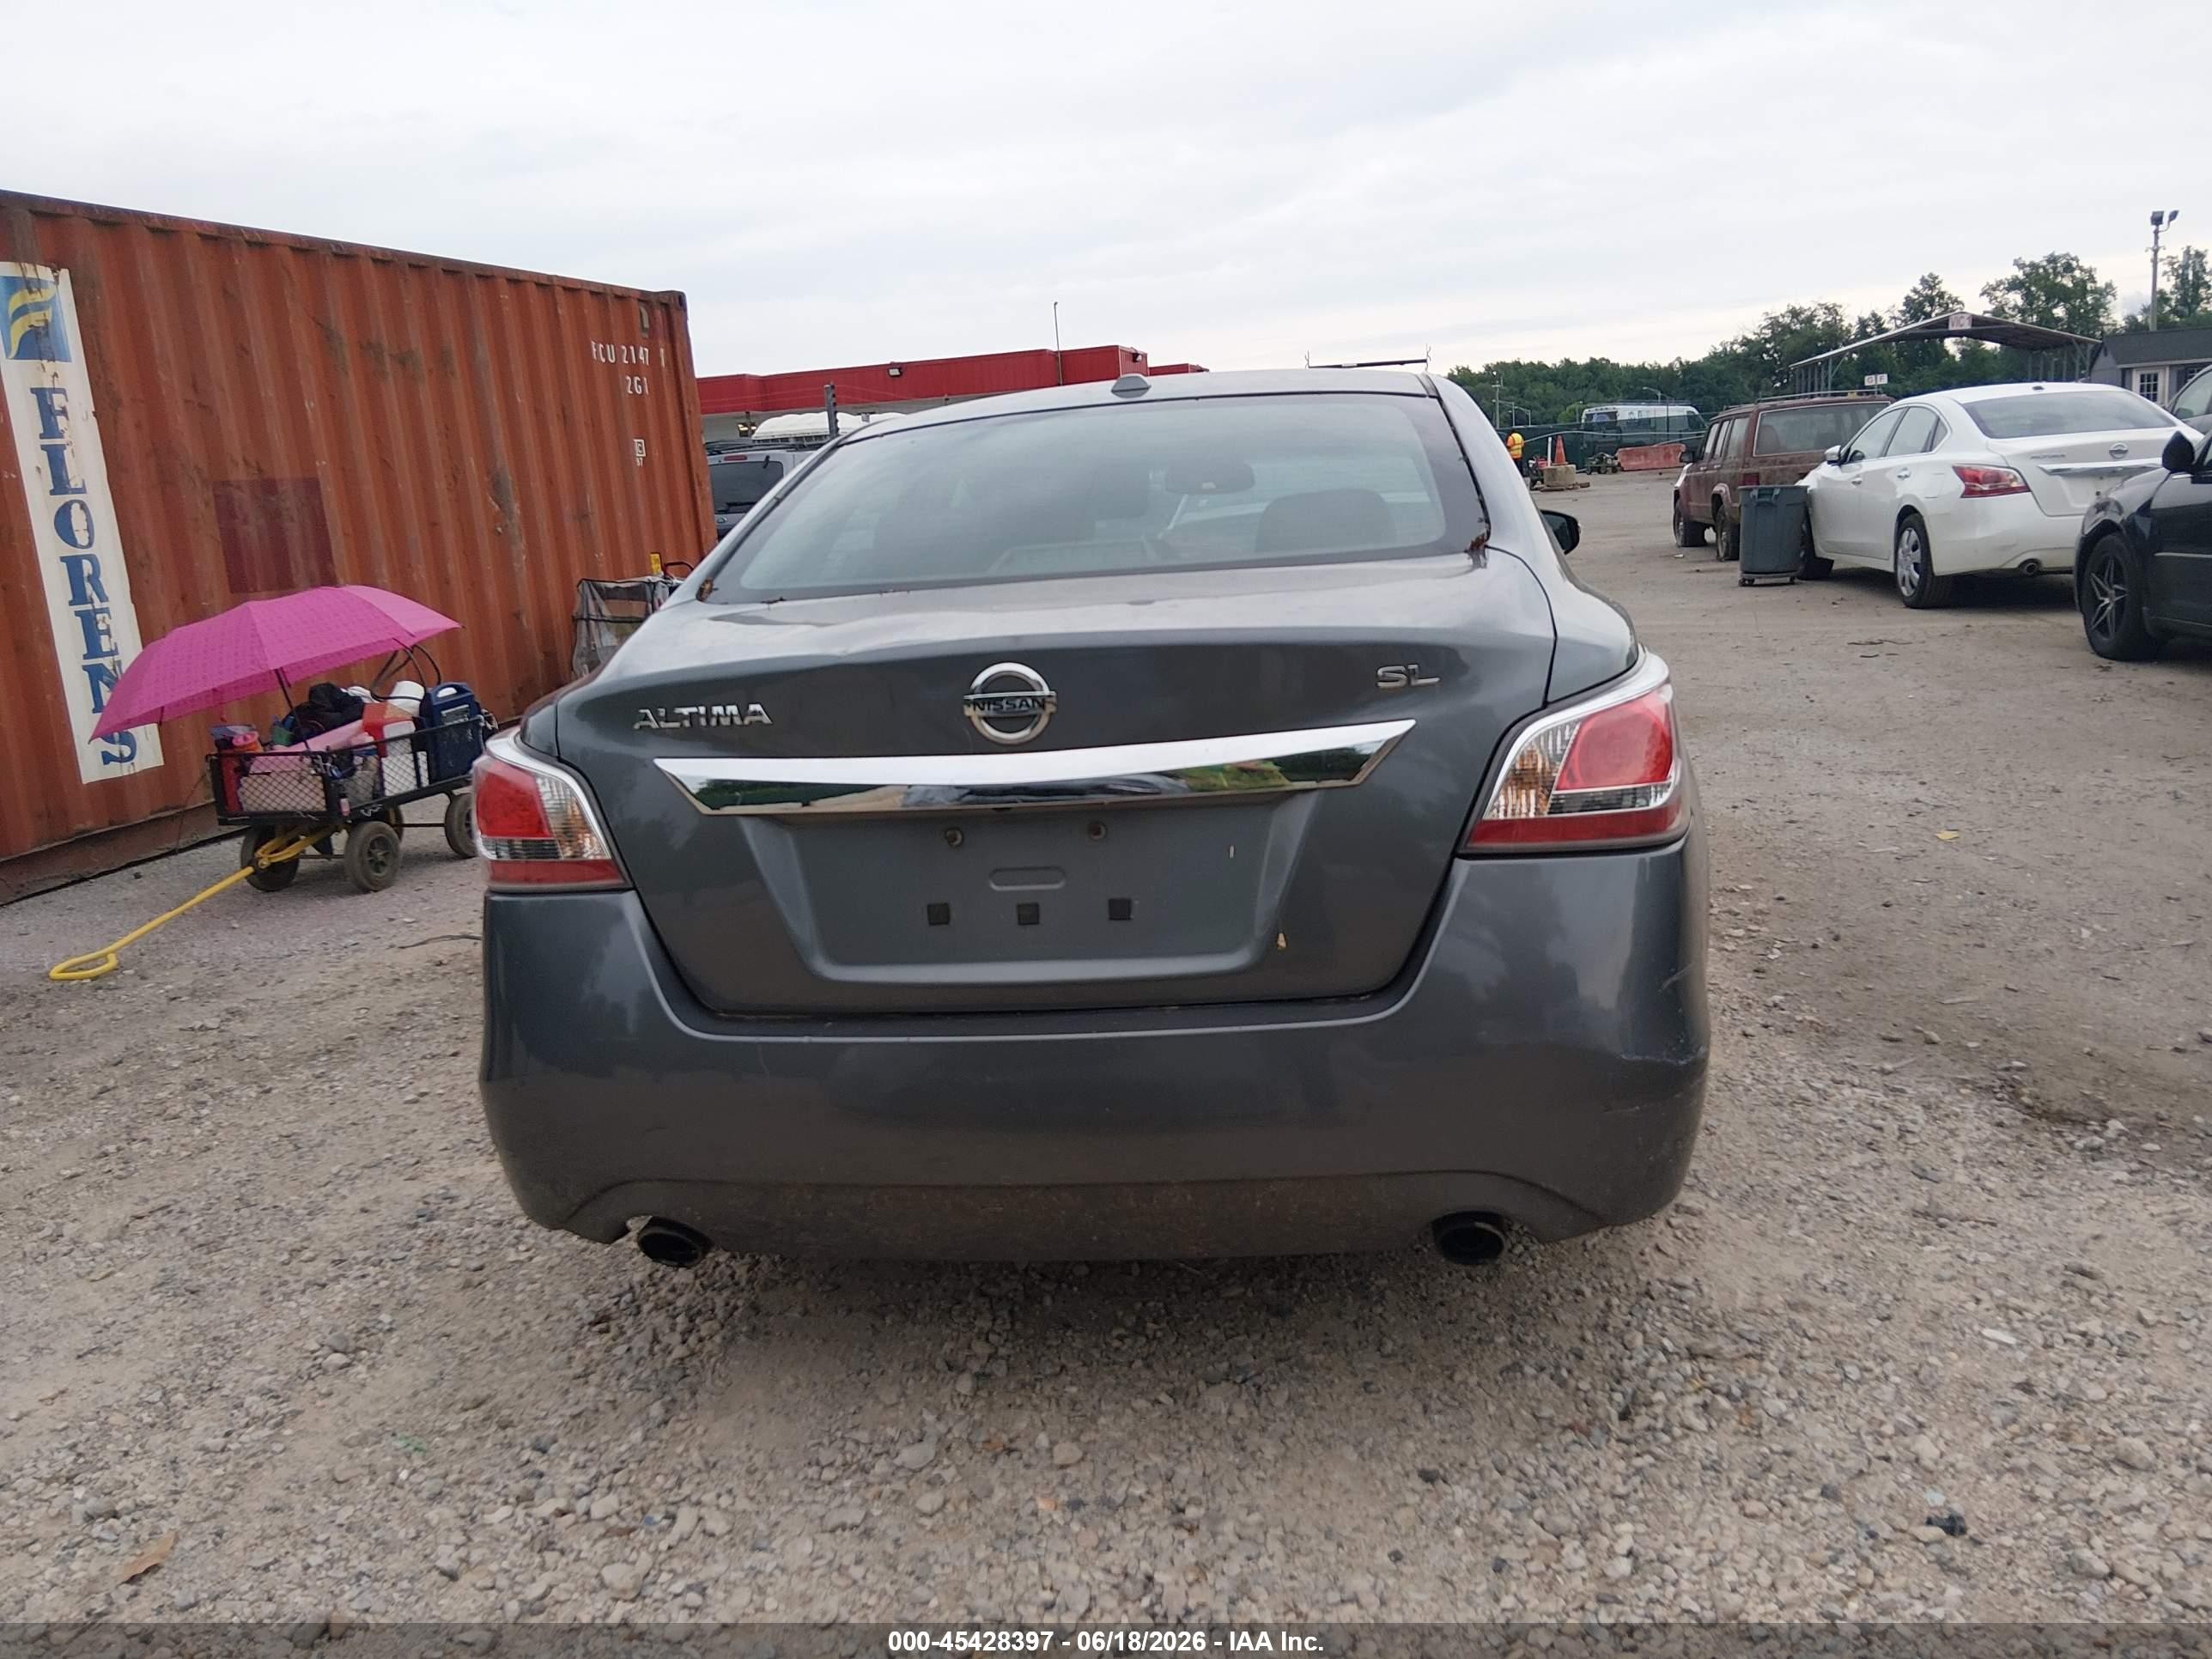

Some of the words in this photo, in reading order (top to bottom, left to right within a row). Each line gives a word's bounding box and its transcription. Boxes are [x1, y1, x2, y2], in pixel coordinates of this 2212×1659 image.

[1376, 664, 1440, 687] SL
[973, 696, 1046, 711] NISSAN
[633, 703, 773, 730] ALTIMA
